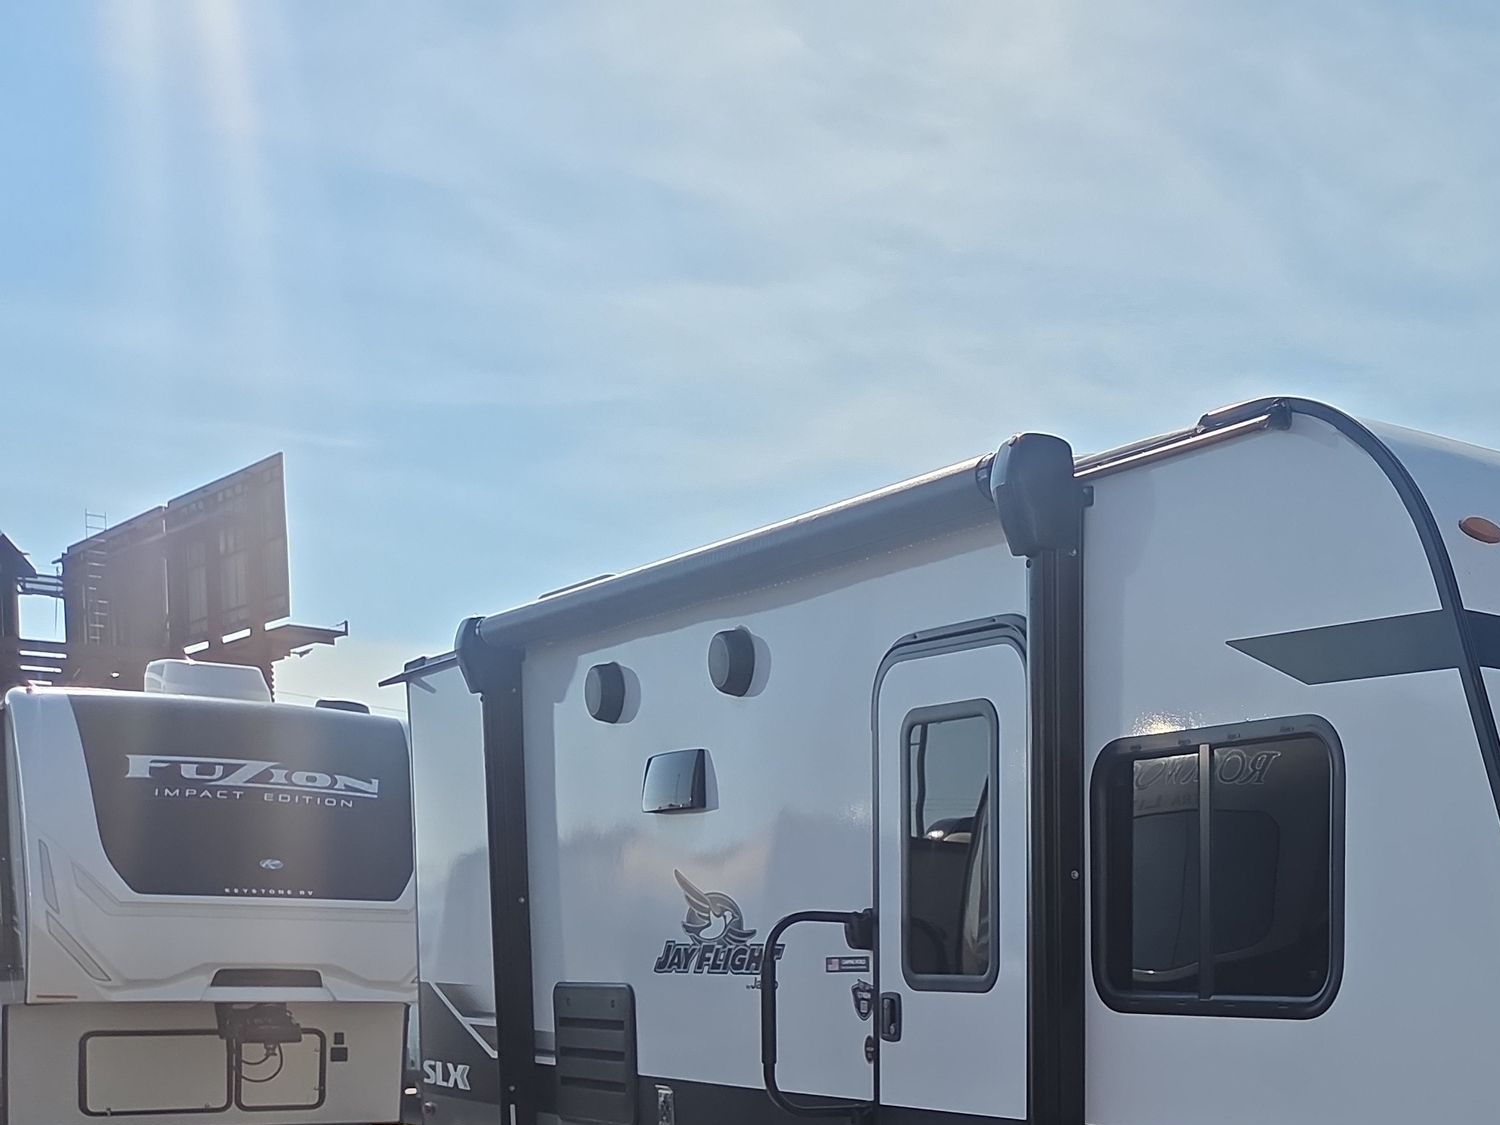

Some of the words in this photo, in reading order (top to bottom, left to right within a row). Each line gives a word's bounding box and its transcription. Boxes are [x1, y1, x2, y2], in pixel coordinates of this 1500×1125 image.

[125, 754, 380, 799] FUZION
[154, 787, 245, 800] IMPACT
[263, 793, 353, 808] EDITION
[224, 887, 293, 896] KEYSTONE
[653, 940, 700, 975] JAY
[422, 1060, 471, 1091] SLX
